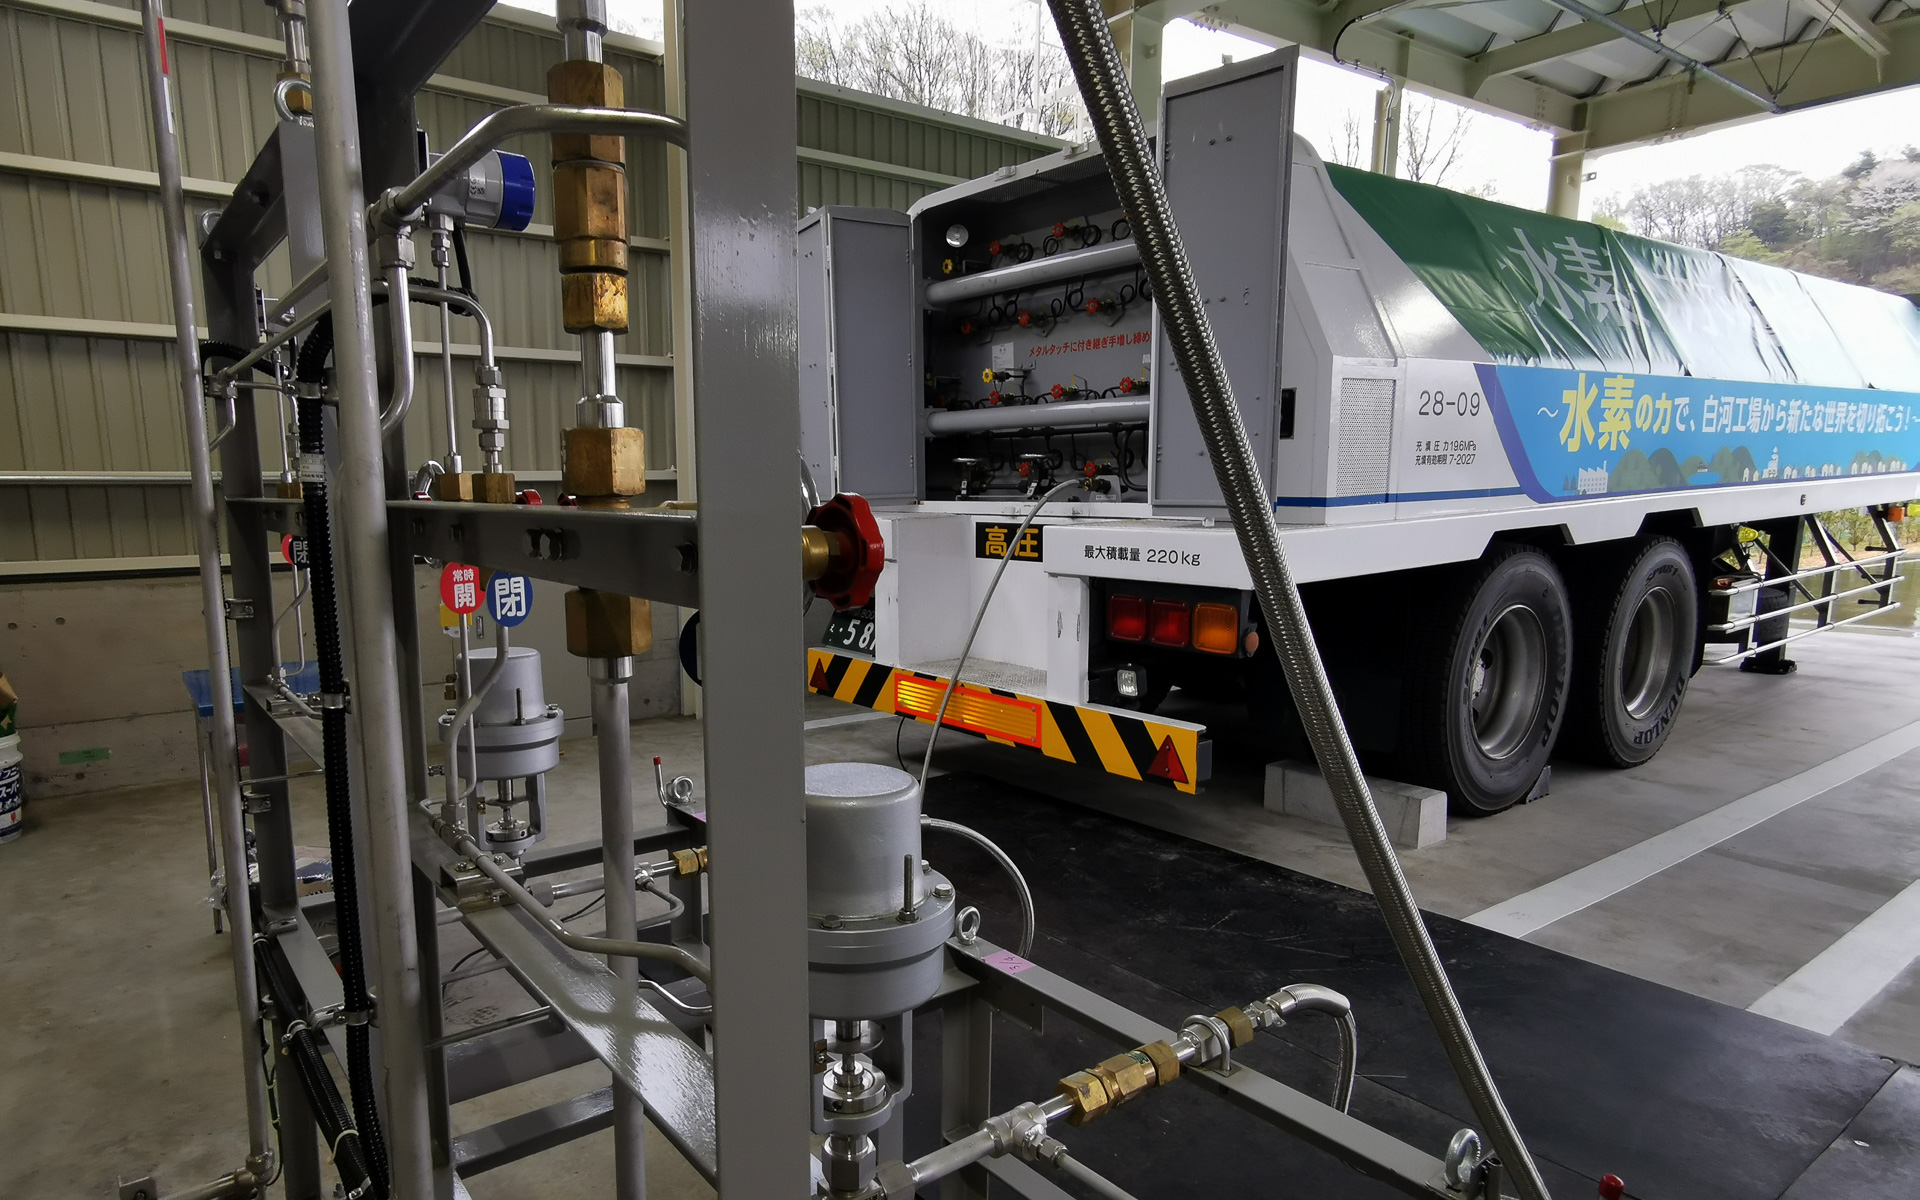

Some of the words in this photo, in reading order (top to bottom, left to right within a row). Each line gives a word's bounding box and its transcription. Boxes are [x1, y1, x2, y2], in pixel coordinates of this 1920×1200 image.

[1507, 227, 1650, 328] 水素
[1029, 331, 1151, 358] メタルタッチに付き継ぎ手増し締め
[1419, 390, 1480, 416] 28-09
[1449, 453, 1476, 465] 7-2027
[293, 541, 310, 564] 閉
[985, 525, 1039, 558] 高圧
[1084, 544, 1141, 562] 最大積載量
[1146, 548, 1201, 567] 220kg
[452, 569, 475, 583] 常時
[453, 582, 476, 609] 開
[494, 576, 527, 620] 閉
[1633, 671, 1686, 745] DUNLOP
